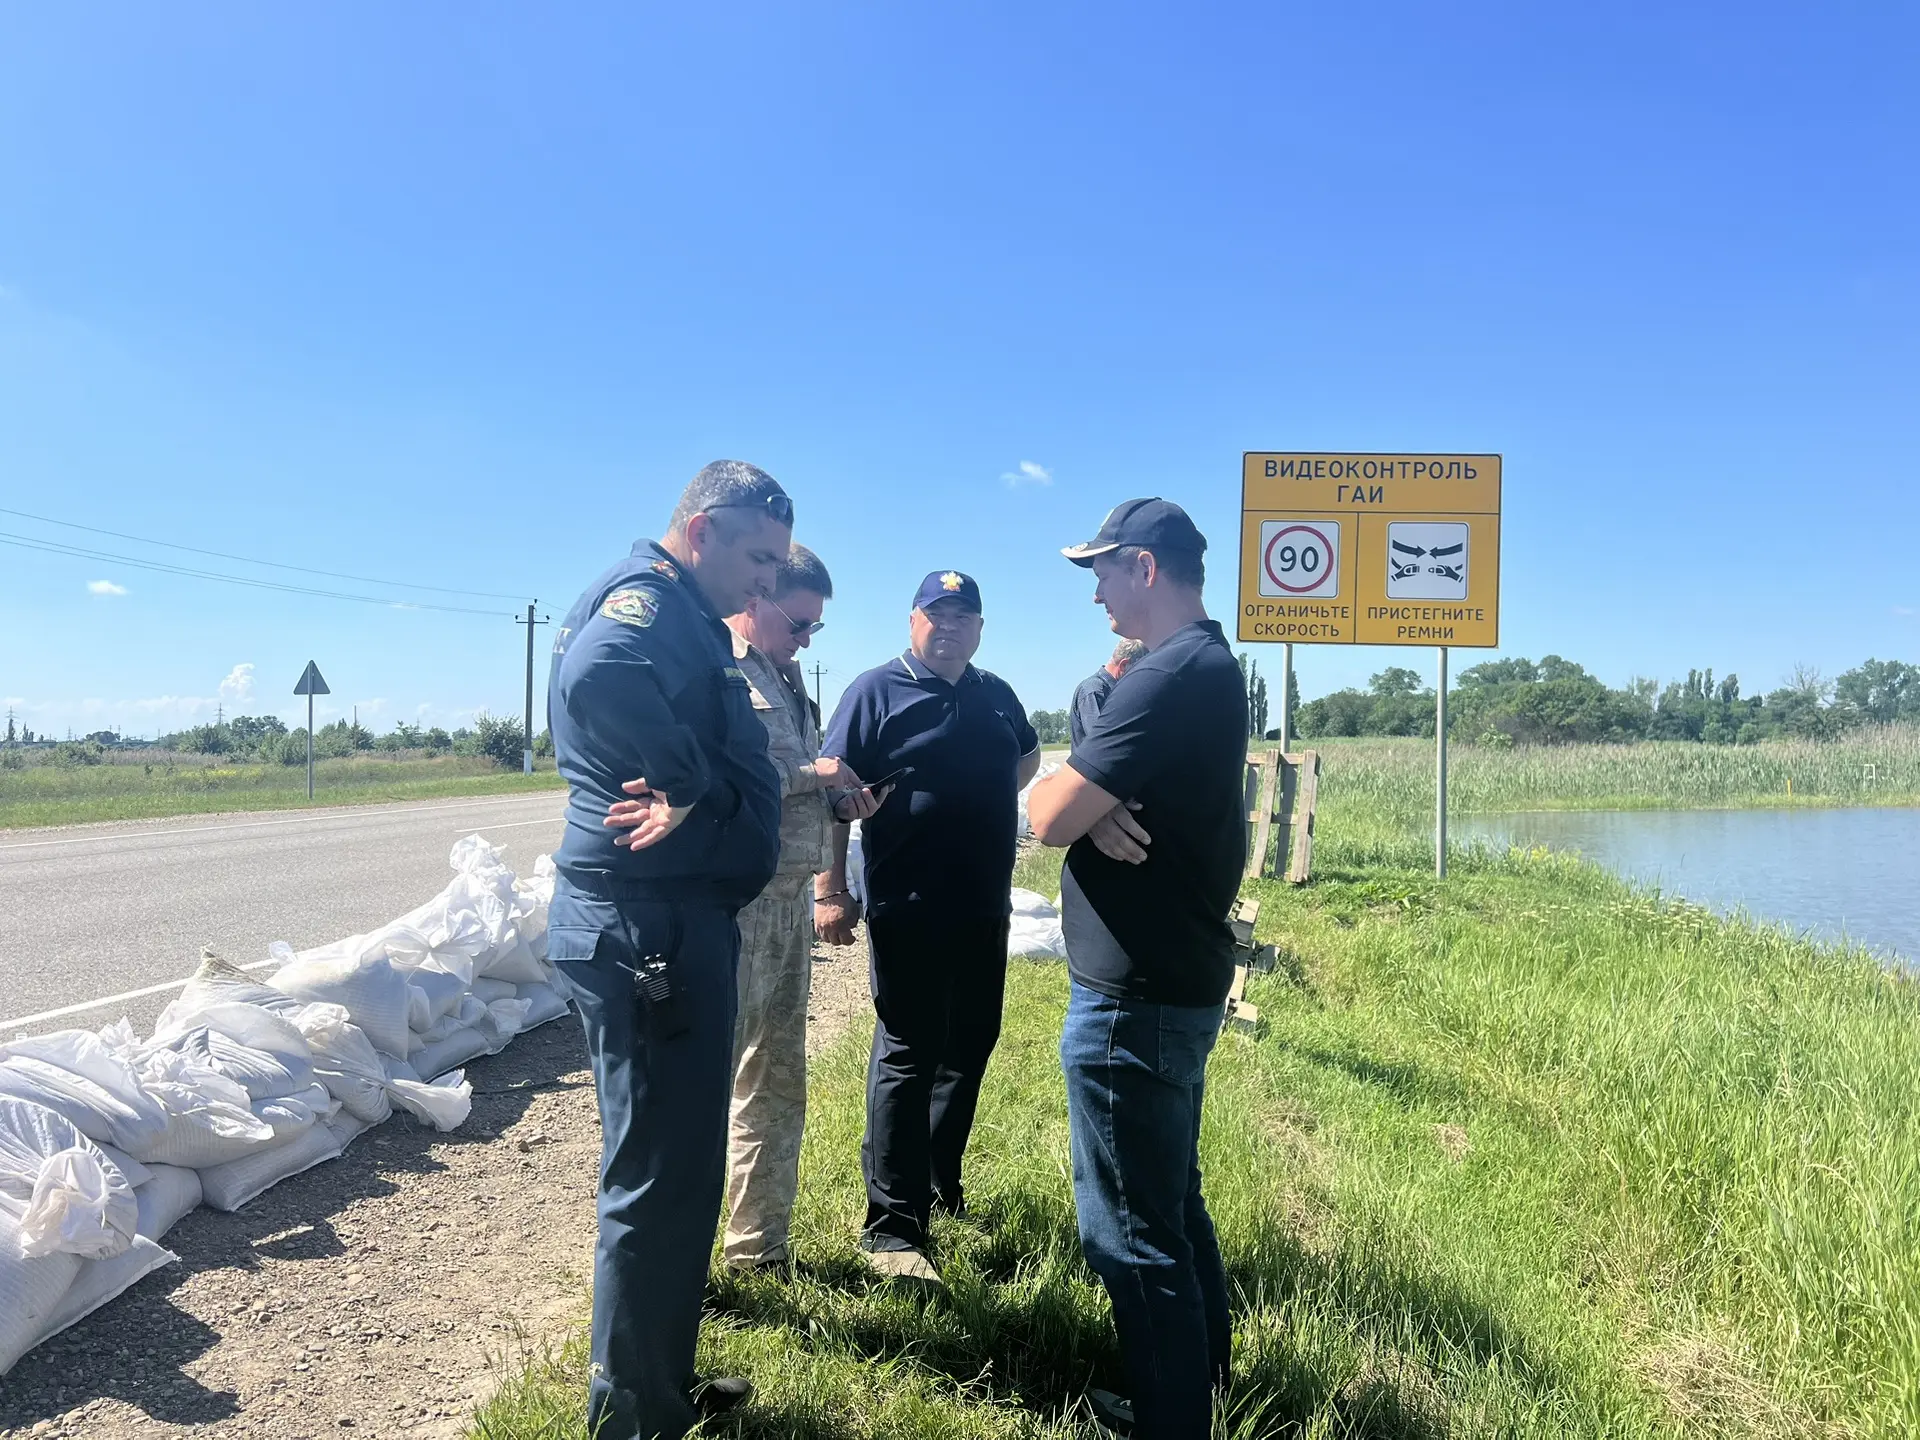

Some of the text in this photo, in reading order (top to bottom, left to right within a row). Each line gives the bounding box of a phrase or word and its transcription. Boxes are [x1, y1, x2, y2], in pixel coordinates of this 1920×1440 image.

[1265, 460, 1477, 481] ВИДЕОКОНТРОЛЬ
[1337, 485, 1384, 504] ГАИ
[1279, 546, 1320, 573] 90
[1245, 604, 1350, 619] ОГРАНИЧЬТЕ
[1368, 606, 1484, 621] ПРИСТЕГНИТЕ
[1254, 623, 1340, 637] СКОРОСТЬ
[1397, 625, 1454, 639] РЕМНИ
